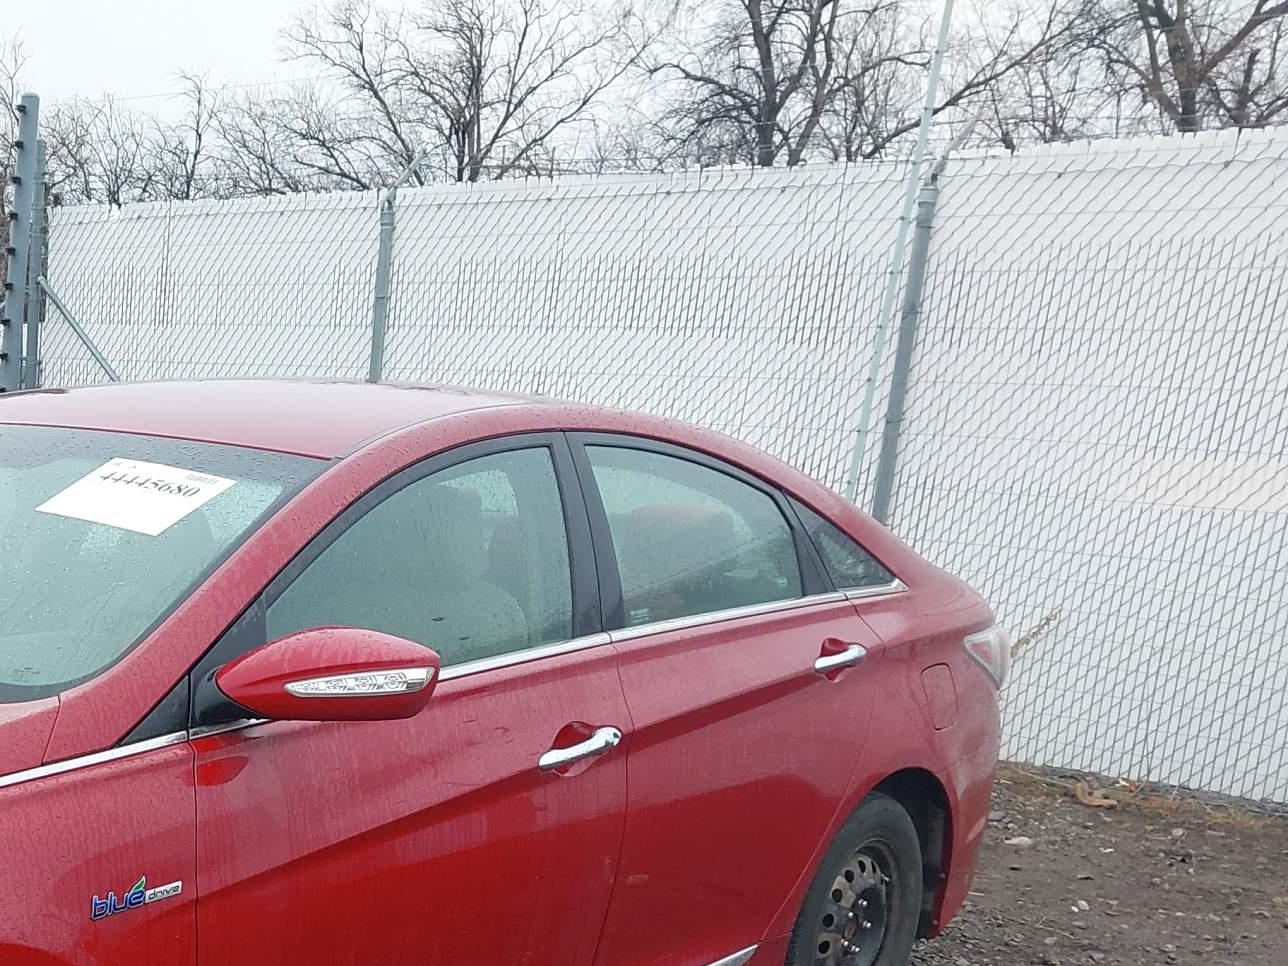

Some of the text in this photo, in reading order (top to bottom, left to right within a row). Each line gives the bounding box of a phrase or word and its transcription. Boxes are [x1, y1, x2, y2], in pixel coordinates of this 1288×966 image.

[100, 471, 201, 498] 44445680
[91, 884, 180, 921] blue drive
